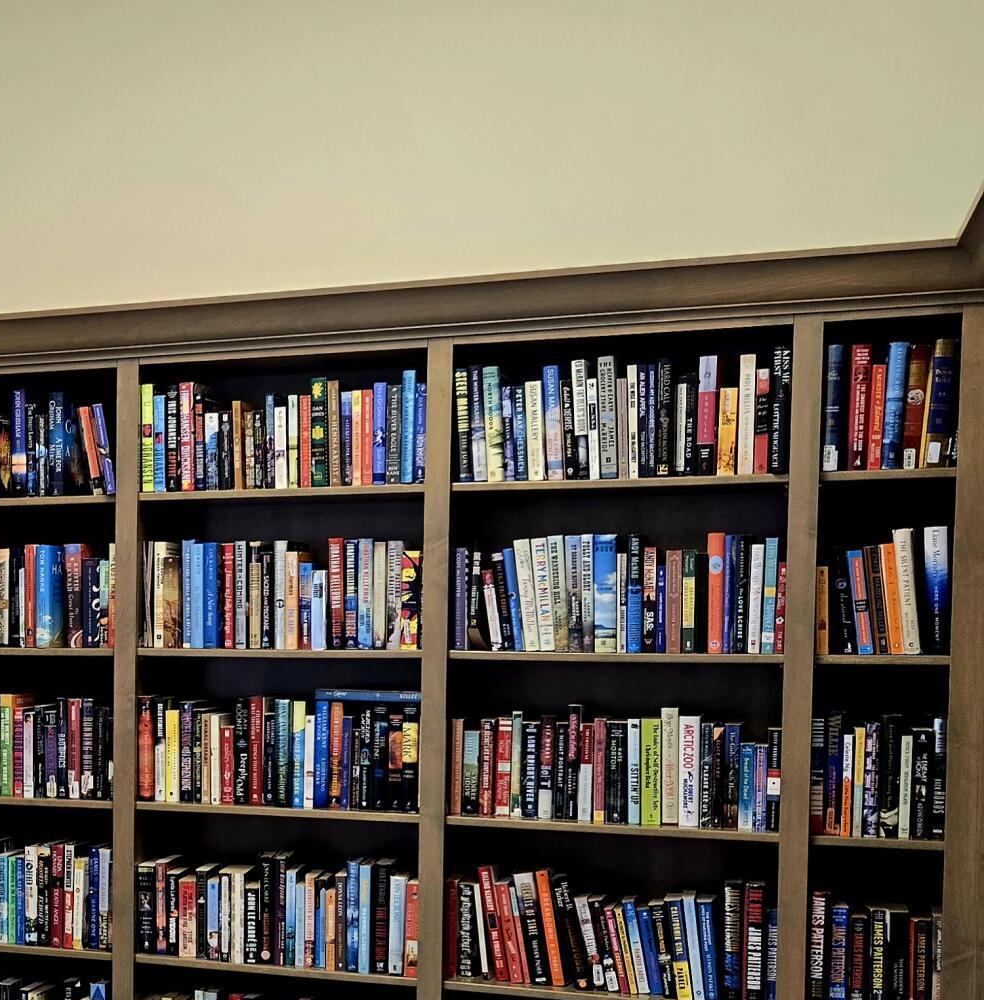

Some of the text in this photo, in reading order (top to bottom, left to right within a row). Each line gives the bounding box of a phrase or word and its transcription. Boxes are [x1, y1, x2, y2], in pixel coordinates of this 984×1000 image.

[168, 400, 176, 414] IRIS
[530, 384, 539, 441] SUSAN MALLERY
[168, 416, 177, 448] JOHANSEN
[535, 543, 546, 573] TERRY
[903, 580, 911, 606] PATIENT
[402, 727, 411, 757] MARK
[683, 724, 695, 769] ARCTIC ZOO
[236, 753, 247, 796] Deeply Odd
[631, 796, 638, 805] UP
[247, 892, 256, 909] JOHN
[247, 910, 256, 919] LE
[811, 896, 825, 979] JAMES PATTERSON
[748, 927, 761, 990] JAMES PATTERSON
[873, 921, 883, 989] JAMES PATTERSON
